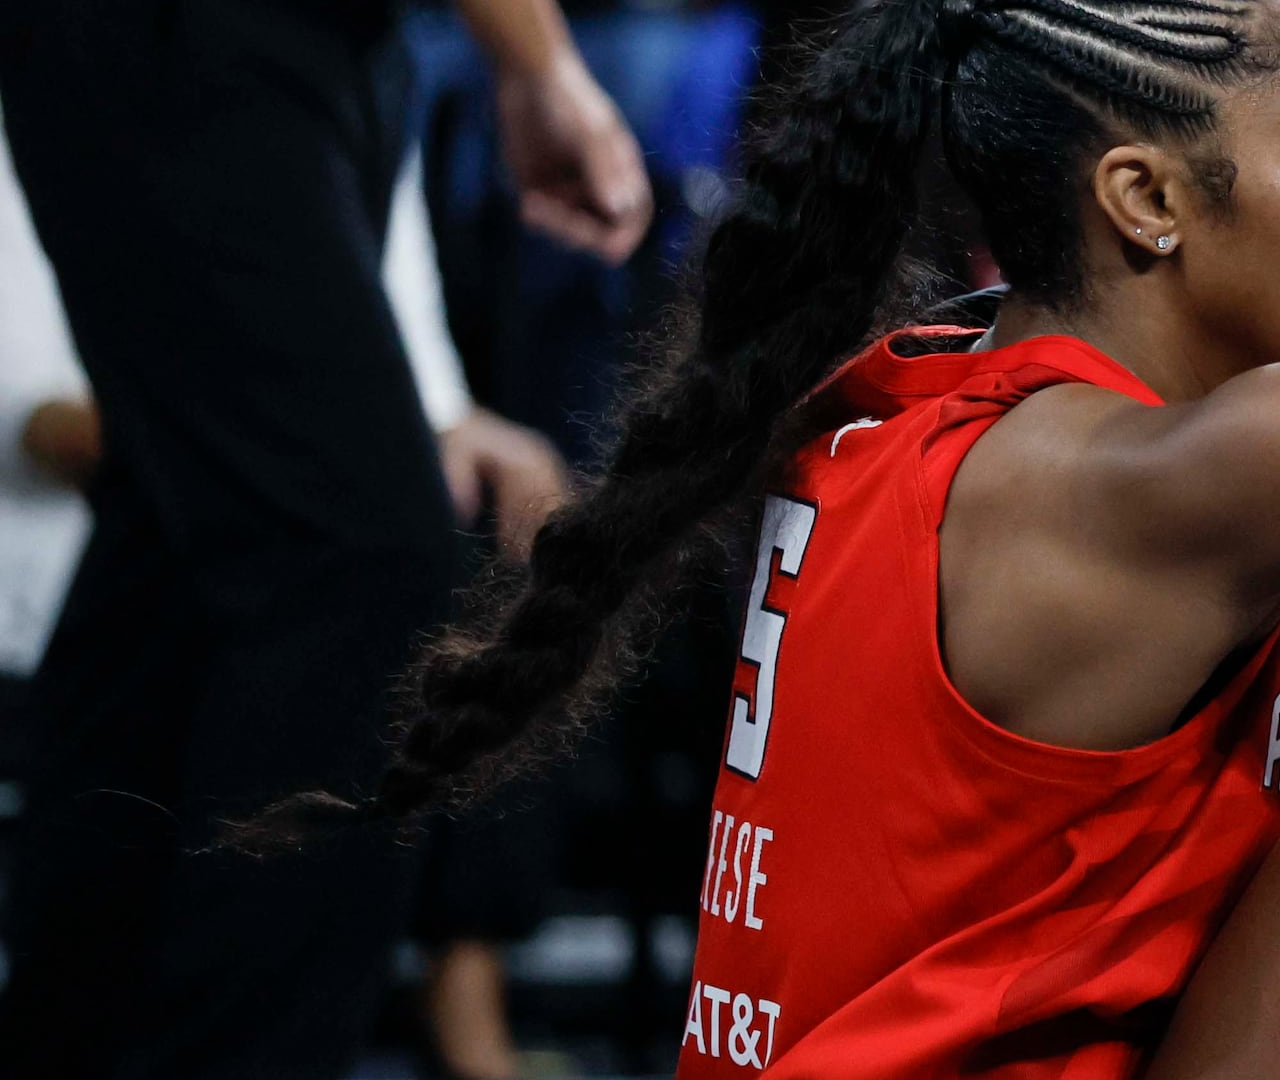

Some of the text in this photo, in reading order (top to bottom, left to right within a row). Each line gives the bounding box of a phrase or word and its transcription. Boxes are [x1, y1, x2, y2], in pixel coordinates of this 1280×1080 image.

[725, 493, 817, 780] 5
[700, 809, 774, 931] EESE
[681, 980, 782, 1070] AT&T
